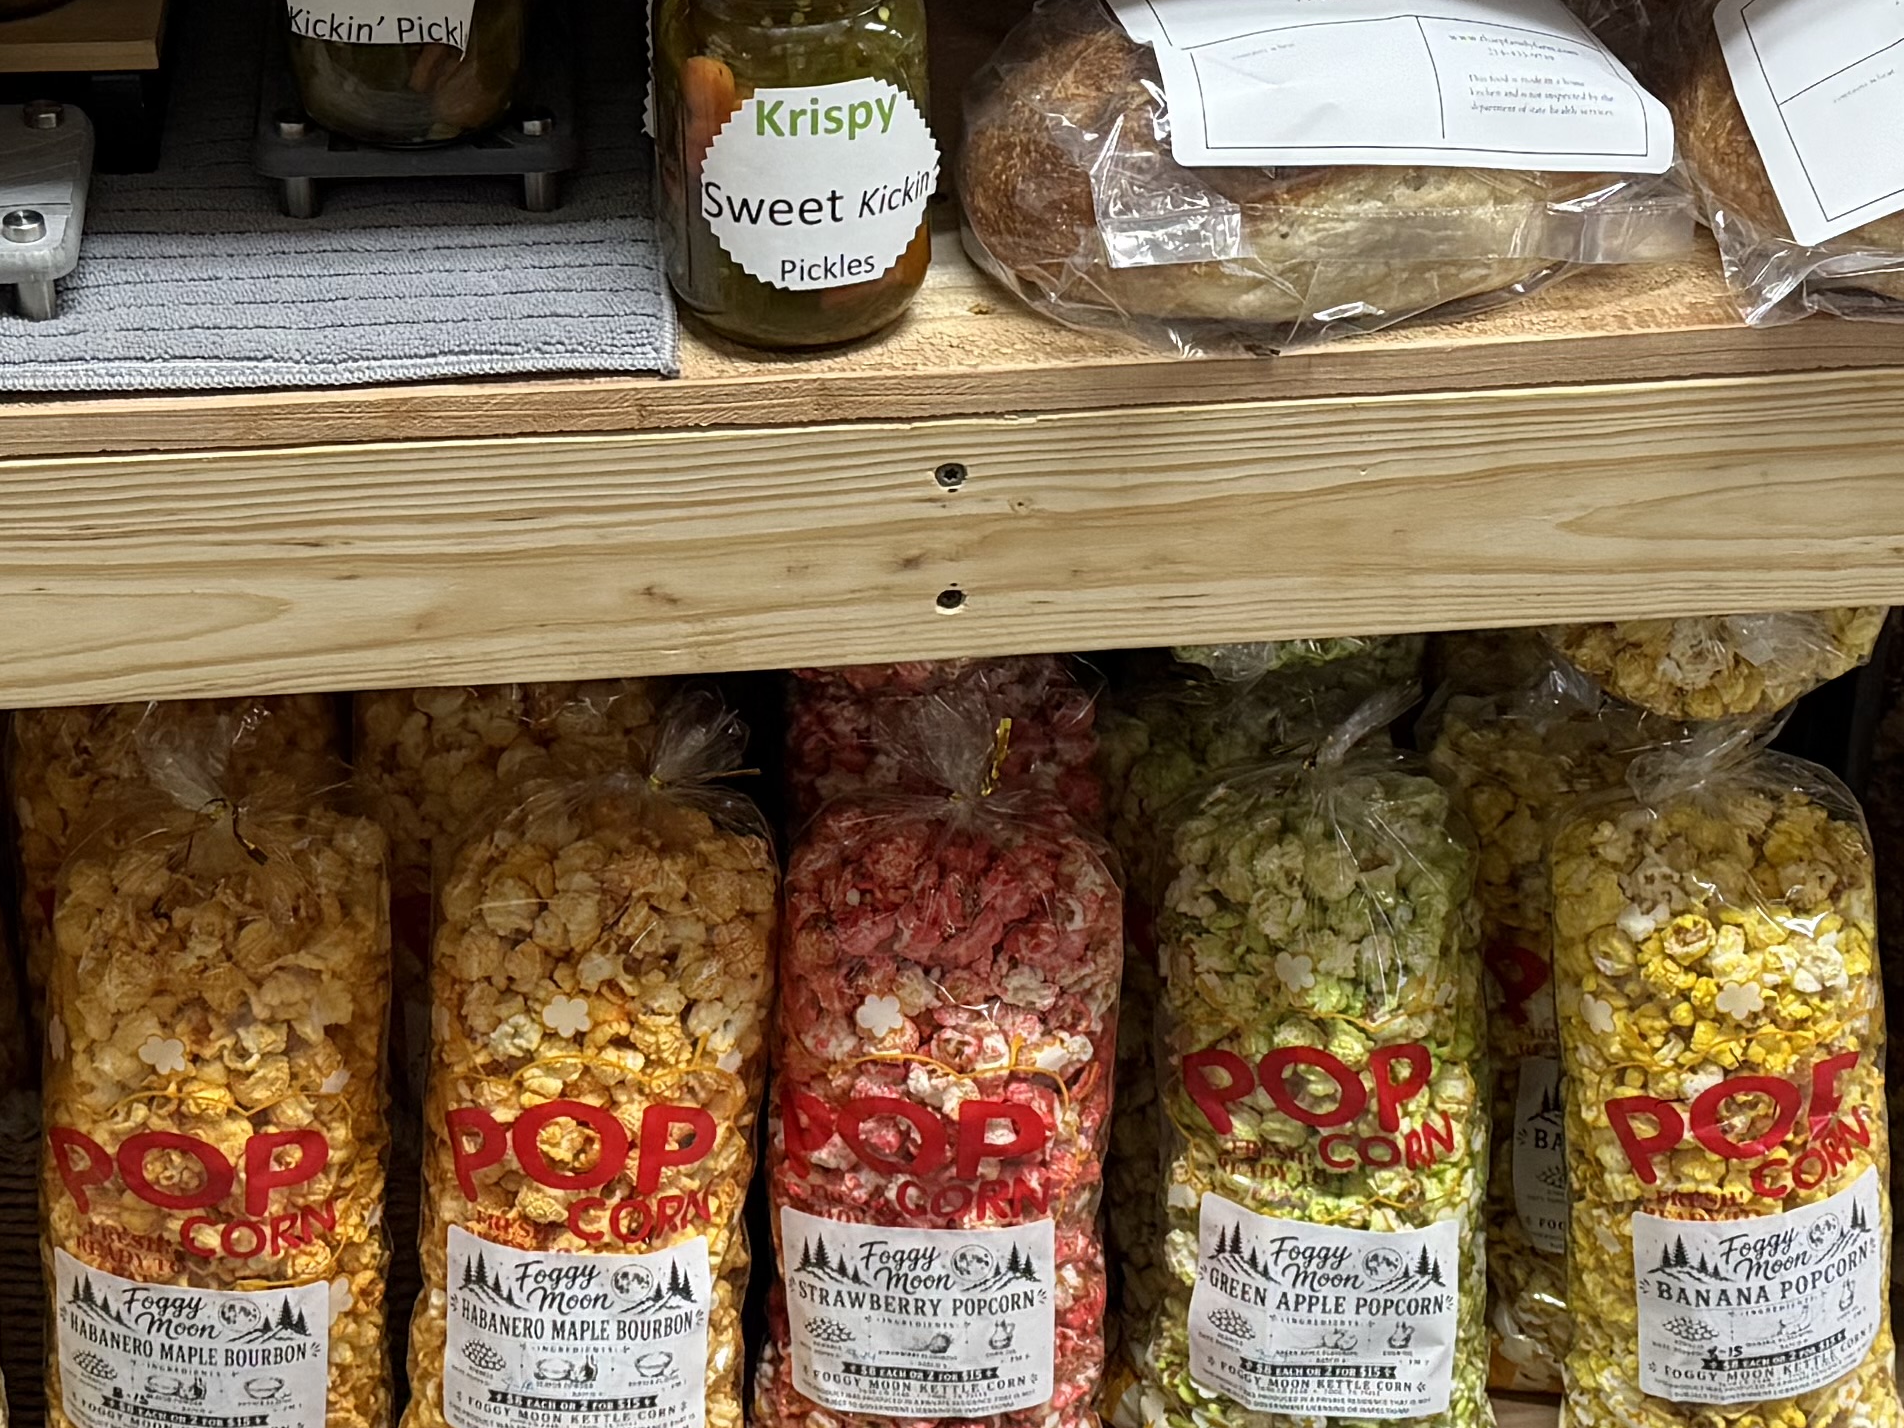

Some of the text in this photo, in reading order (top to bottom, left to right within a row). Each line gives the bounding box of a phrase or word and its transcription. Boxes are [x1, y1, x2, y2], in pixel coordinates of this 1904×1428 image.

[755, 91, 898, 140] Krispy
[703, 180, 845, 227] Sweet
[779, 252, 877, 282] Pickles
[1182, 1043, 1432, 1135] POP
[445, 1099, 718, 1203] POP
[781, 1092, 1057, 1180] POP
[1318, 1110, 1455, 1171] CORN
[1751, 1105, 1871, 1198] CORN
[567, 1185, 712, 1243] CORN
[896, 1176, 1049, 1221] CORN
[859, 1240, 941, 1271] Foggy
[1269, 1236, 1351, 1267] Foggy
[1718, 1226, 1799, 1265] Foggy
[1733, 1249, 1813, 1282] Moon
[514, 1260, 602, 1293] Foggy
[873, 1266, 956, 1295] Moon
[1209, 1266, 1445, 1316] GREEN APPLE POPCORN
[1280, 1261, 1365, 1293] Moon
[1656, 1242, 1869, 1308] BANANA POPCORN
[526, 1286, 615, 1316] Moon
[798, 1279, 1035, 1318] STRAWBERRY POPCORN
[461, 1300, 693, 1341] HABANERO MAPLE BOURBON
